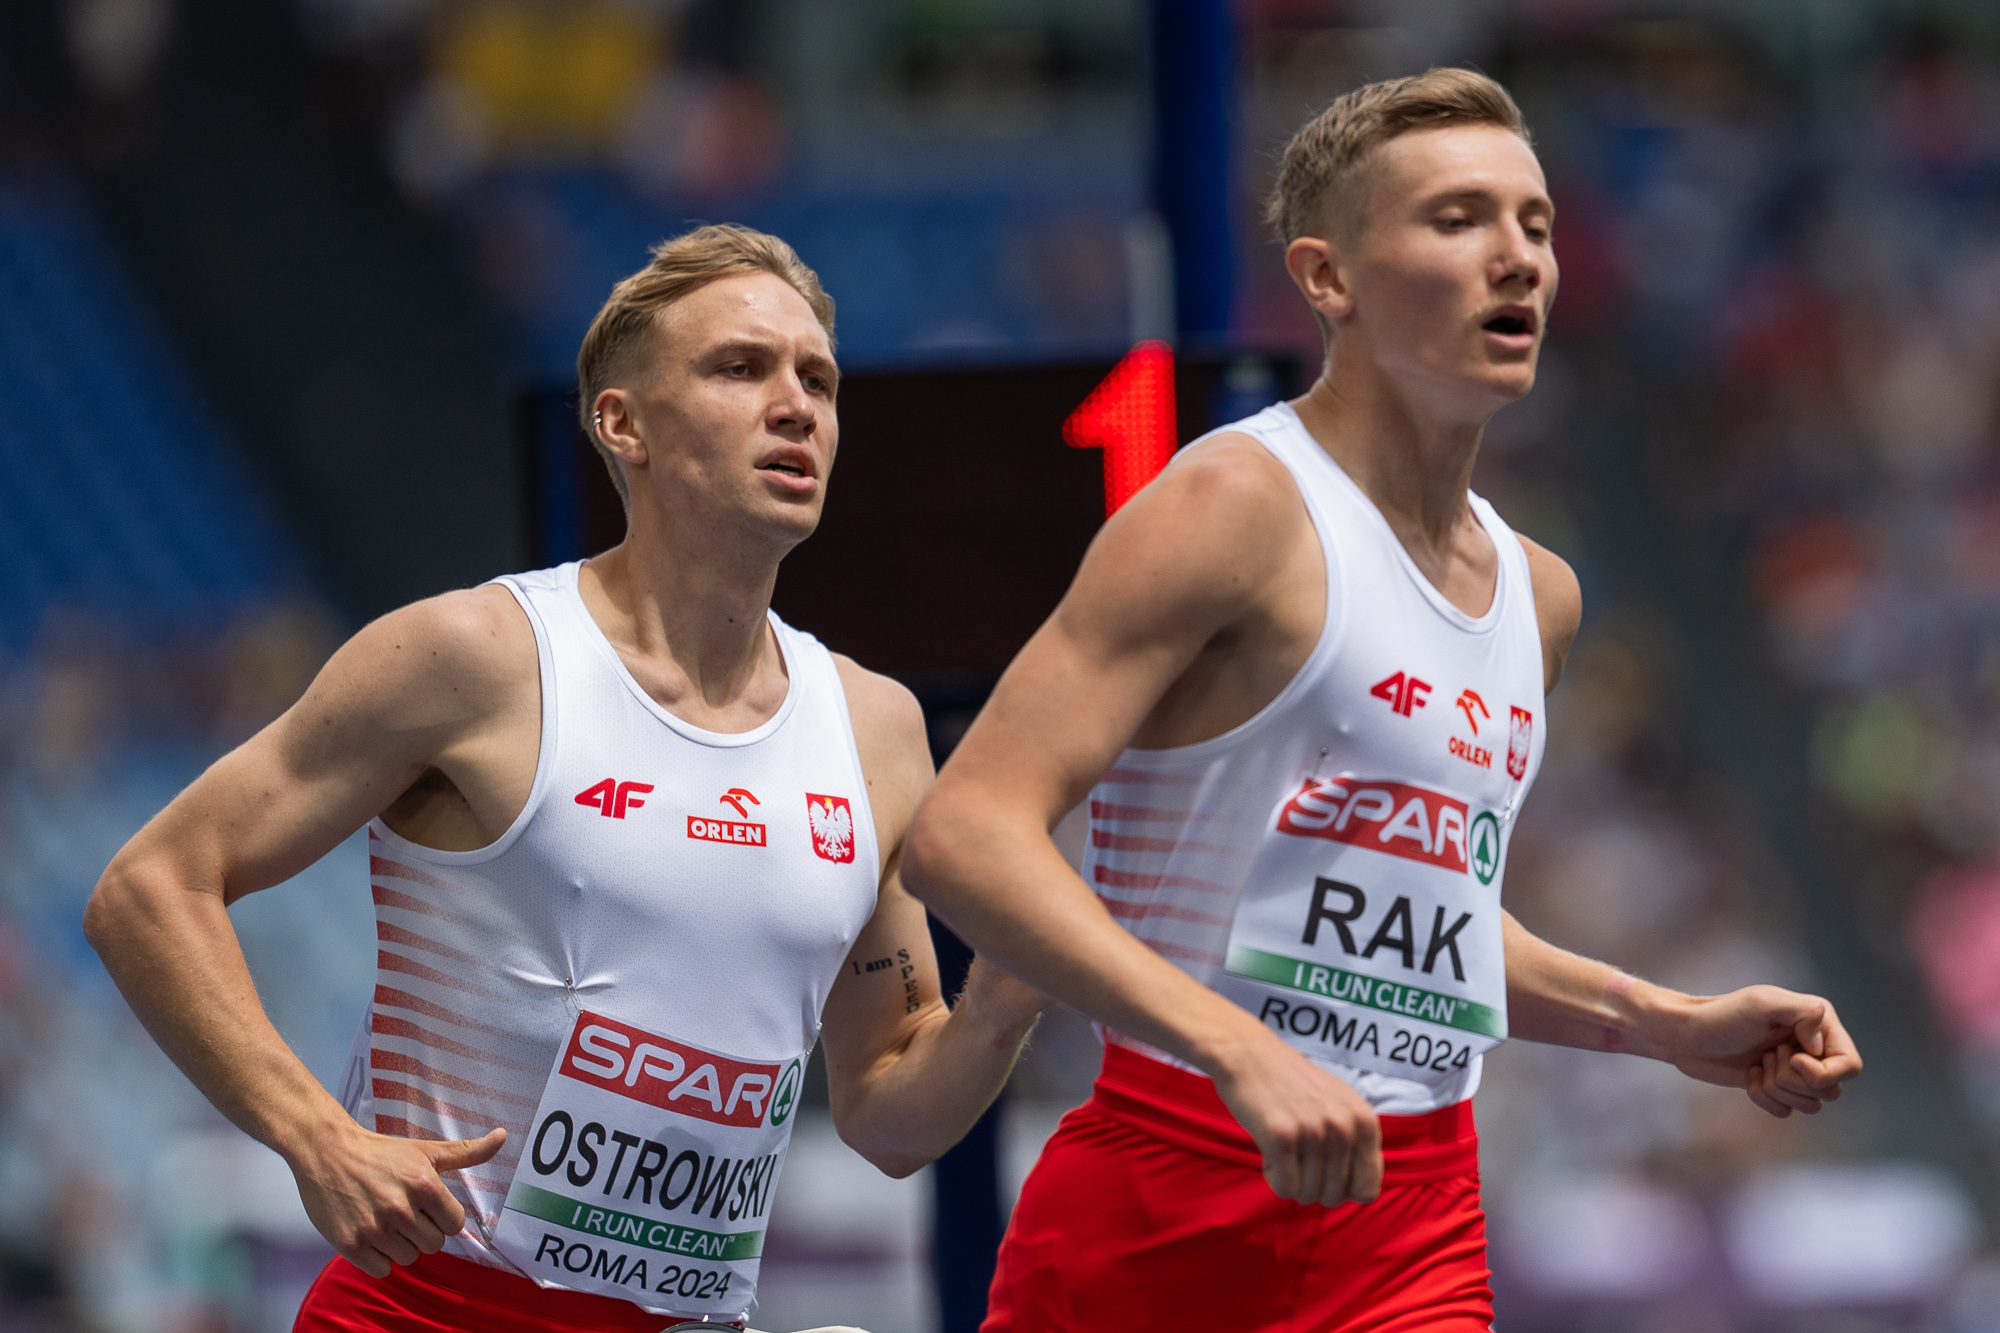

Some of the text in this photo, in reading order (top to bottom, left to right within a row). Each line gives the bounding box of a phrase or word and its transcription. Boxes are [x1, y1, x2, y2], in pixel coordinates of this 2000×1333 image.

[1062, 339, 1178, 521] 1
[1370, 670, 1433, 718] 4F
[1448, 736, 1493, 769] ORLEN
[574, 777, 654, 819] 4F
[1287, 786, 1467, 863] SPAR
[690, 819, 762, 845] ORLEN
[1301, 875, 1473, 983] RAK
[852, 960, 862, 975] I
[865, 957, 893, 973] am
[1294, 962, 1305, 987] I
[1308, 966, 1374, 1002] RUN
[1259, 997, 1472, 1073] ROMA 2024
[571, 1023, 772, 1119] SPAR
[531, 1109, 777, 1222] OSTROWSKI
[570, 1205, 583, 1226] I
[585, 1209, 645, 1243] RUN
[534, 1234, 732, 1299] ROMA 2024
